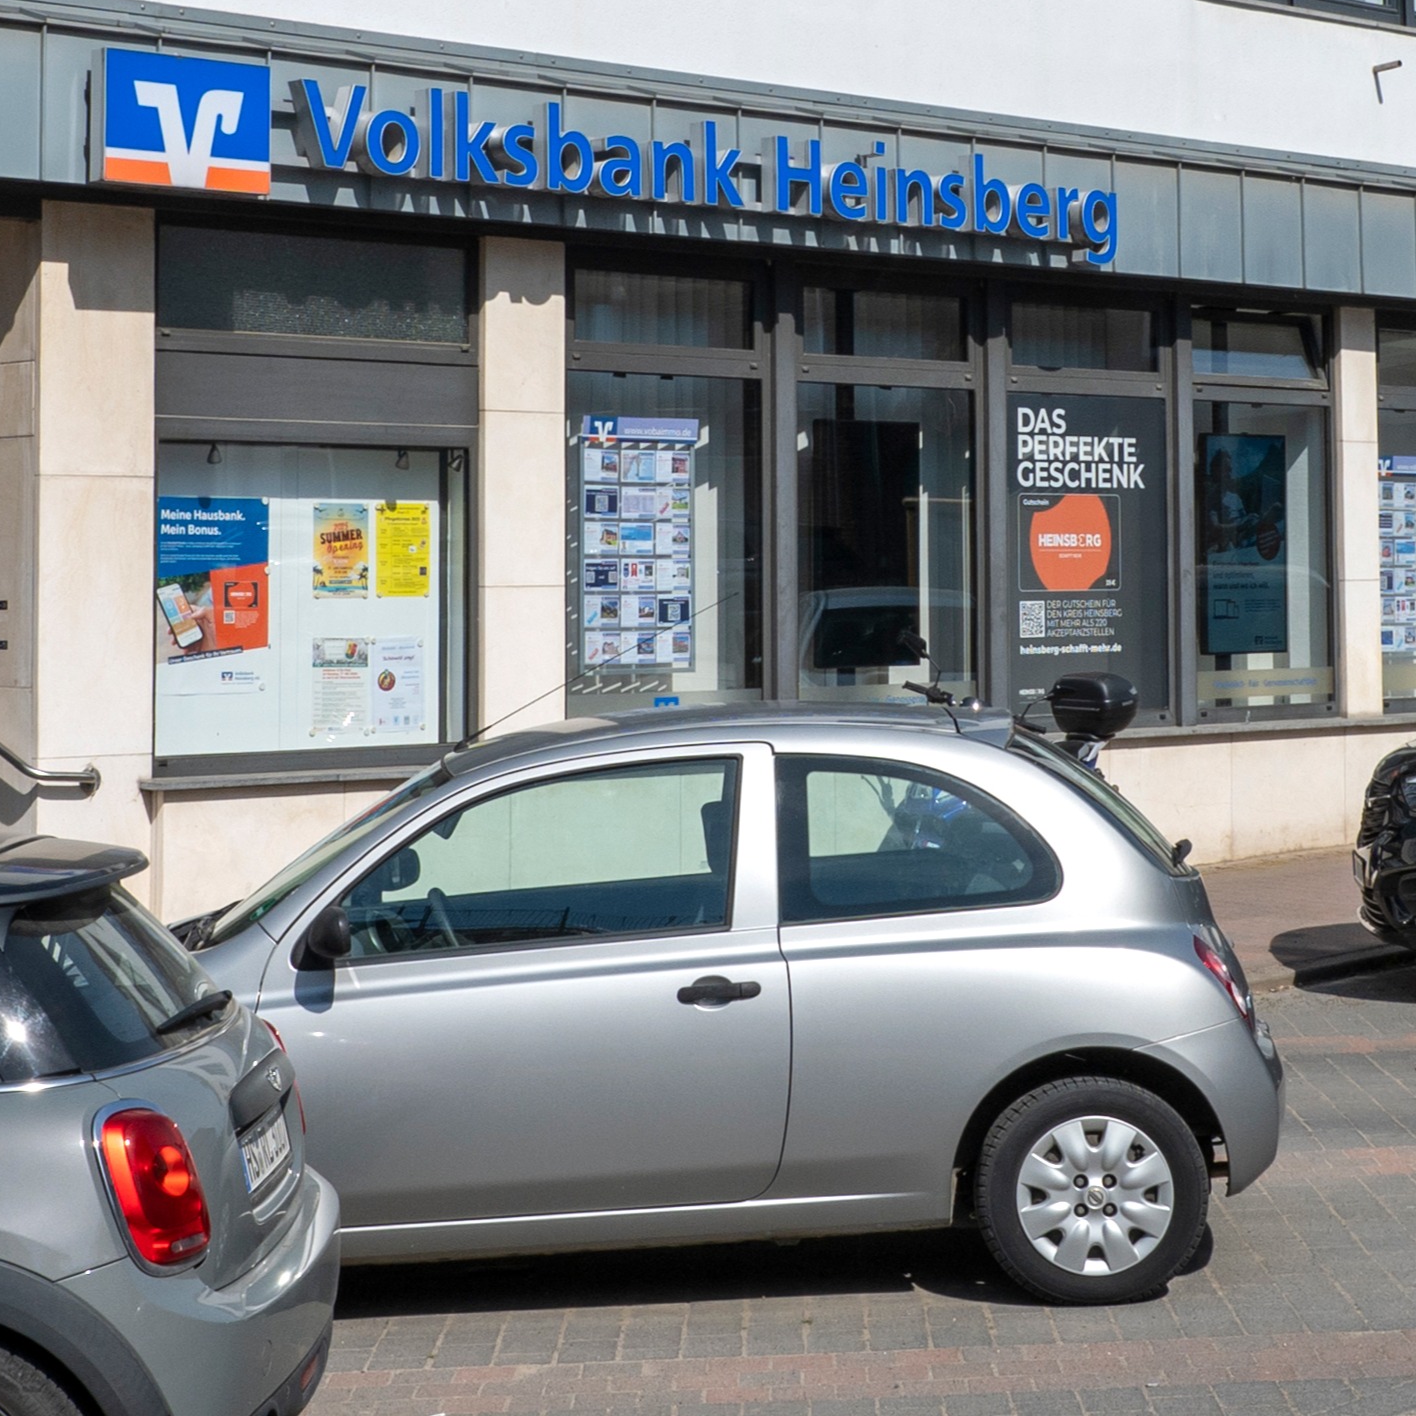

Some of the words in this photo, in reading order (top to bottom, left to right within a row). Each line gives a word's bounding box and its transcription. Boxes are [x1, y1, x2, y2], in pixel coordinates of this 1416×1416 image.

[290, 78, 744, 209] Volksbank
[768, 135, 1119, 266] Heinsberg
[1016, 406, 1067, 435] DAS
[1017, 434, 1138, 463] PERFEKTE
[1016, 461, 1146, 489] GESCHENK
[160, 508, 192, 520] Meine
[193, 509, 246, 521] Hausbank.
[160, 523, 186, 535] Mein
[187, 524, 222, 535] Bonus.
[320, 528, 363, 545] SUMMER
[326, 540, 364, 555] Opening
[1046, 600, 1061, 609] DER
[1062, 599, 1101, 609] GUTSCHEIN
[1102, 598, 1116, 608] FÜR
[1046, 609, 1062, 618] DEN
[1063, 609, 1083, 618] KREIS
[1084, 608, 1123, 618] HEINSBERG
[1046, 619, 1059, 628] MIT
[1060, 619, 1081, 627] MEHR
[1081, 619, 1094, 627] ALS
[1095, 618, 1108, 627] 220
[1046, 627, 1115, 637] AKZEPTANZSTELLEN
[1019, 642, 1123, 656] heinsberg-schafft-mehr.de
